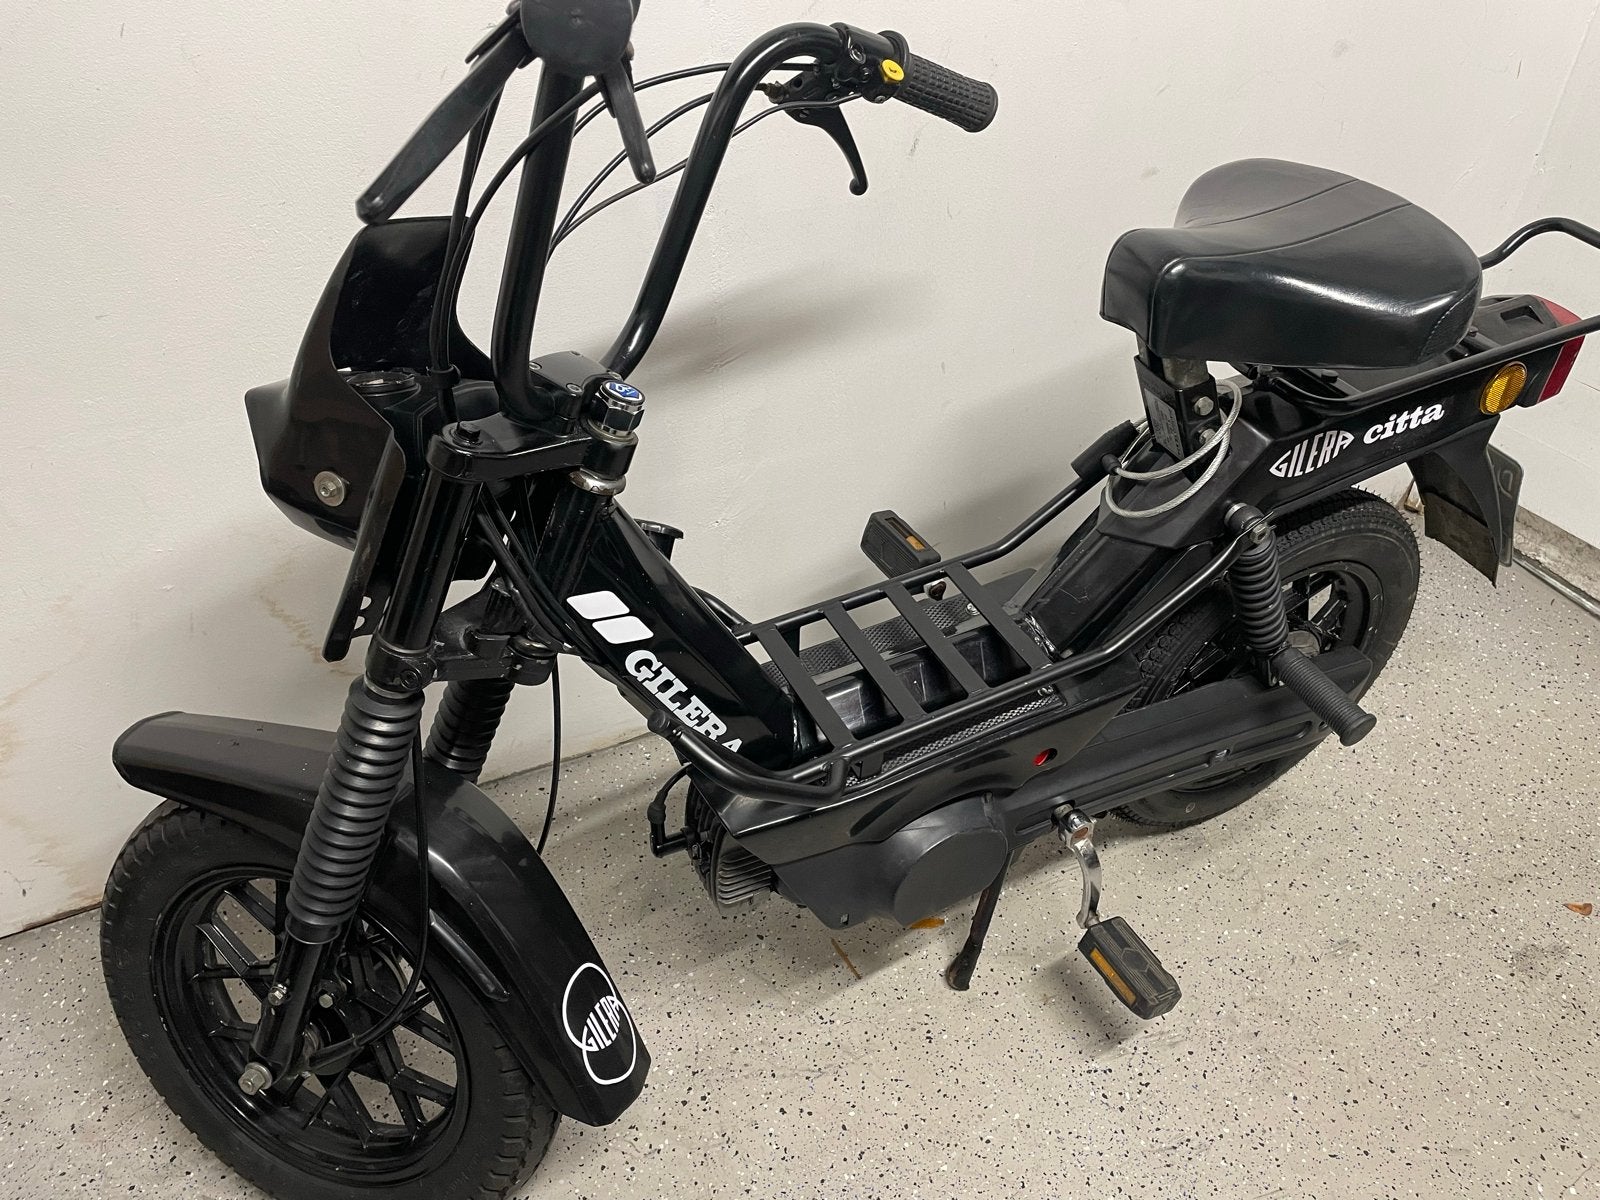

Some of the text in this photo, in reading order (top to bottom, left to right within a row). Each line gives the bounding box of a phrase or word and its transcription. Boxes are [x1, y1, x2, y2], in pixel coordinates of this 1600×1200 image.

[1269, 403, 1445, 478] GILERA citta
[582, 995, 621, 1052] GILERA
